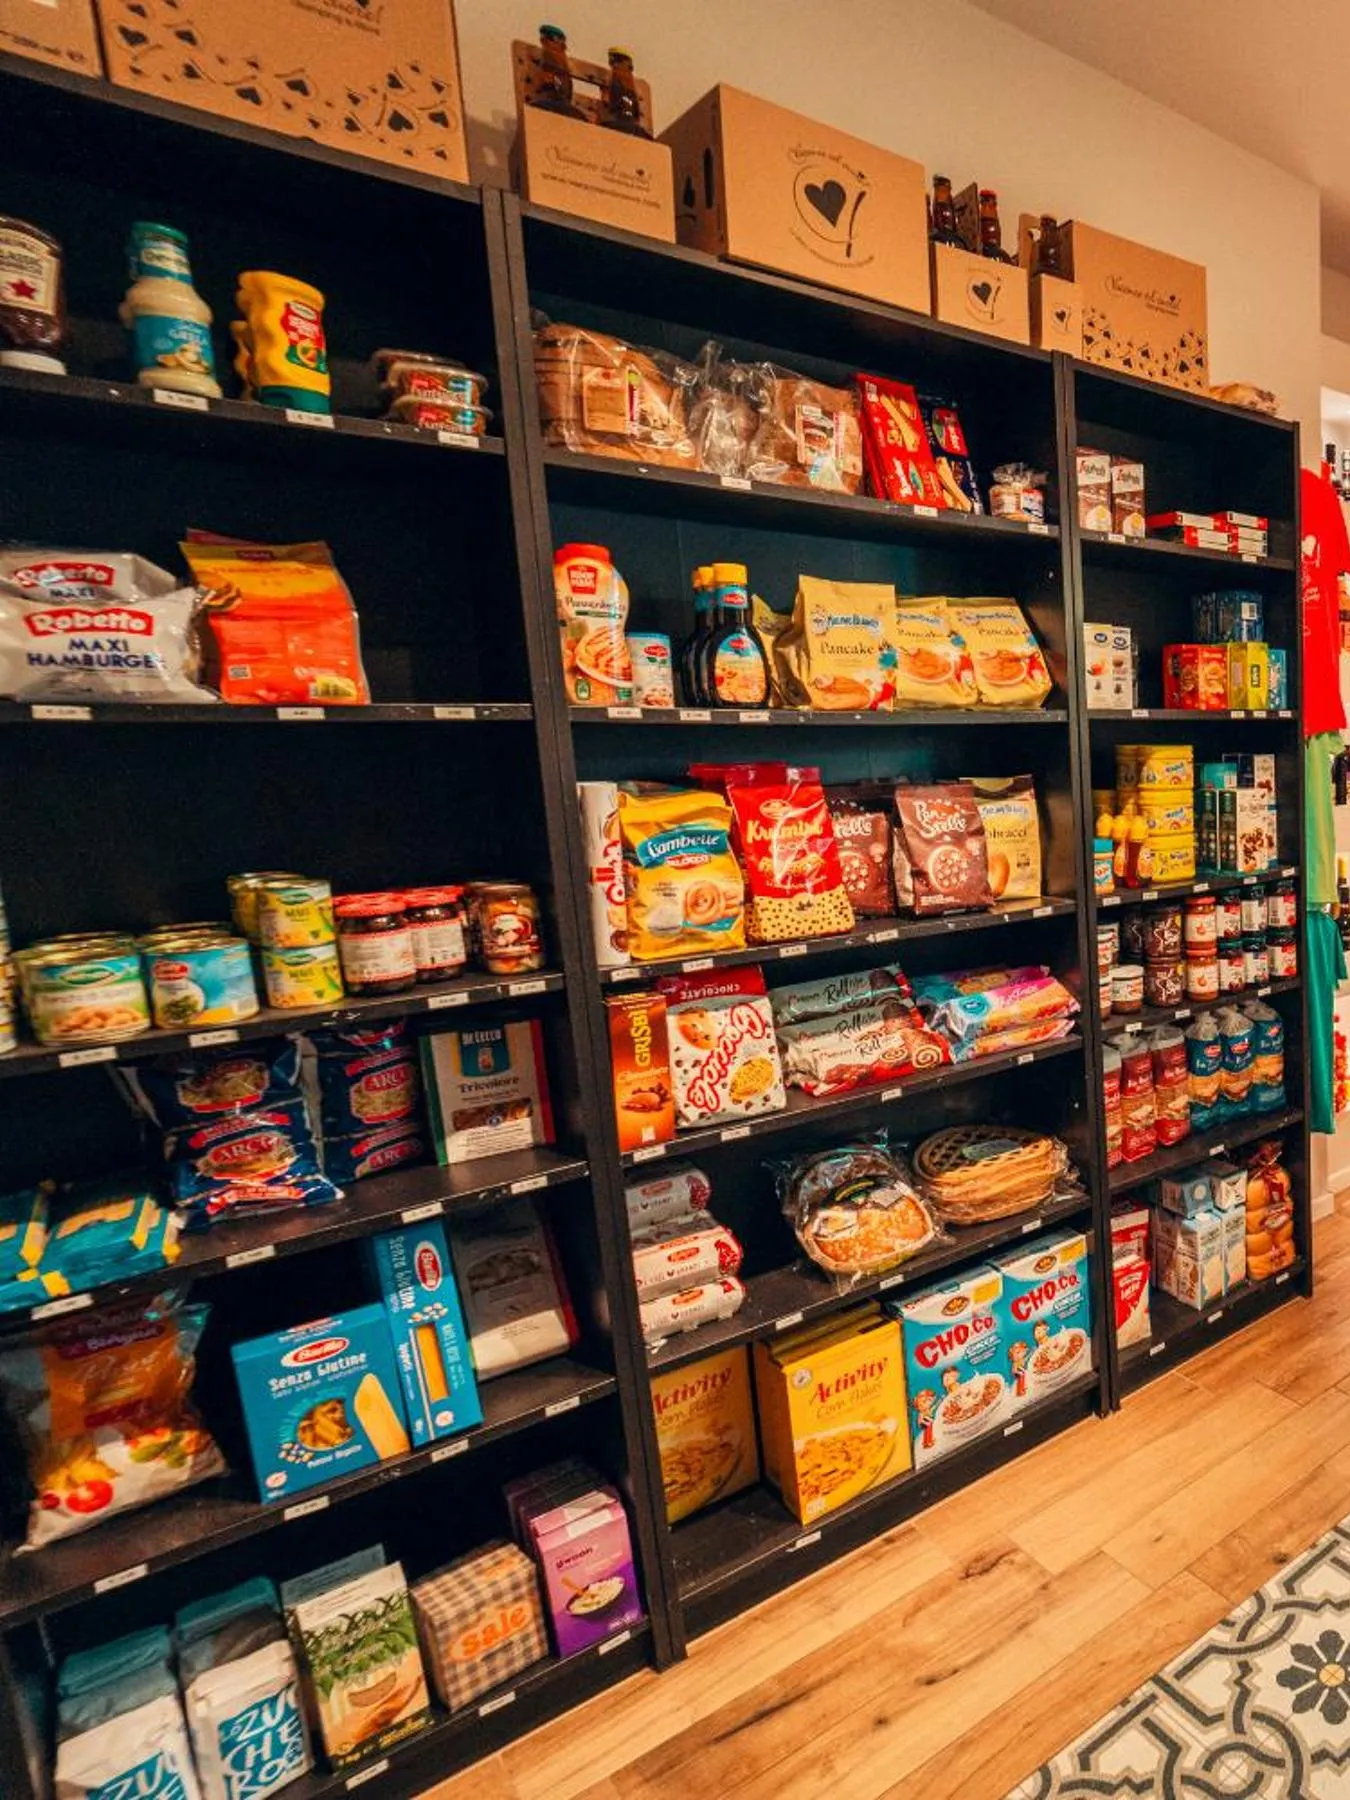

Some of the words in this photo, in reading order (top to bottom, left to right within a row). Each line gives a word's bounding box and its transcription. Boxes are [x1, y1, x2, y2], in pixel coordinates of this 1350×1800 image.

[31, 612, 147, 633] Roberto
[68, 638, 130, 652] MAXI
[820, 641, 874, 655] Pancake
[26, 652, 164, 669] HAMBURGE
[680, 983, 741, 1000] CHOCOLATE
[459, 1076, 520, 1094] Tricolore
[269, 1371, 313, 1391] Senza
[316, 1352, 367, 1377] Glutine
[808, 1356, 889, 1405] Activity
[460, 1607, 526, 1657] sale
